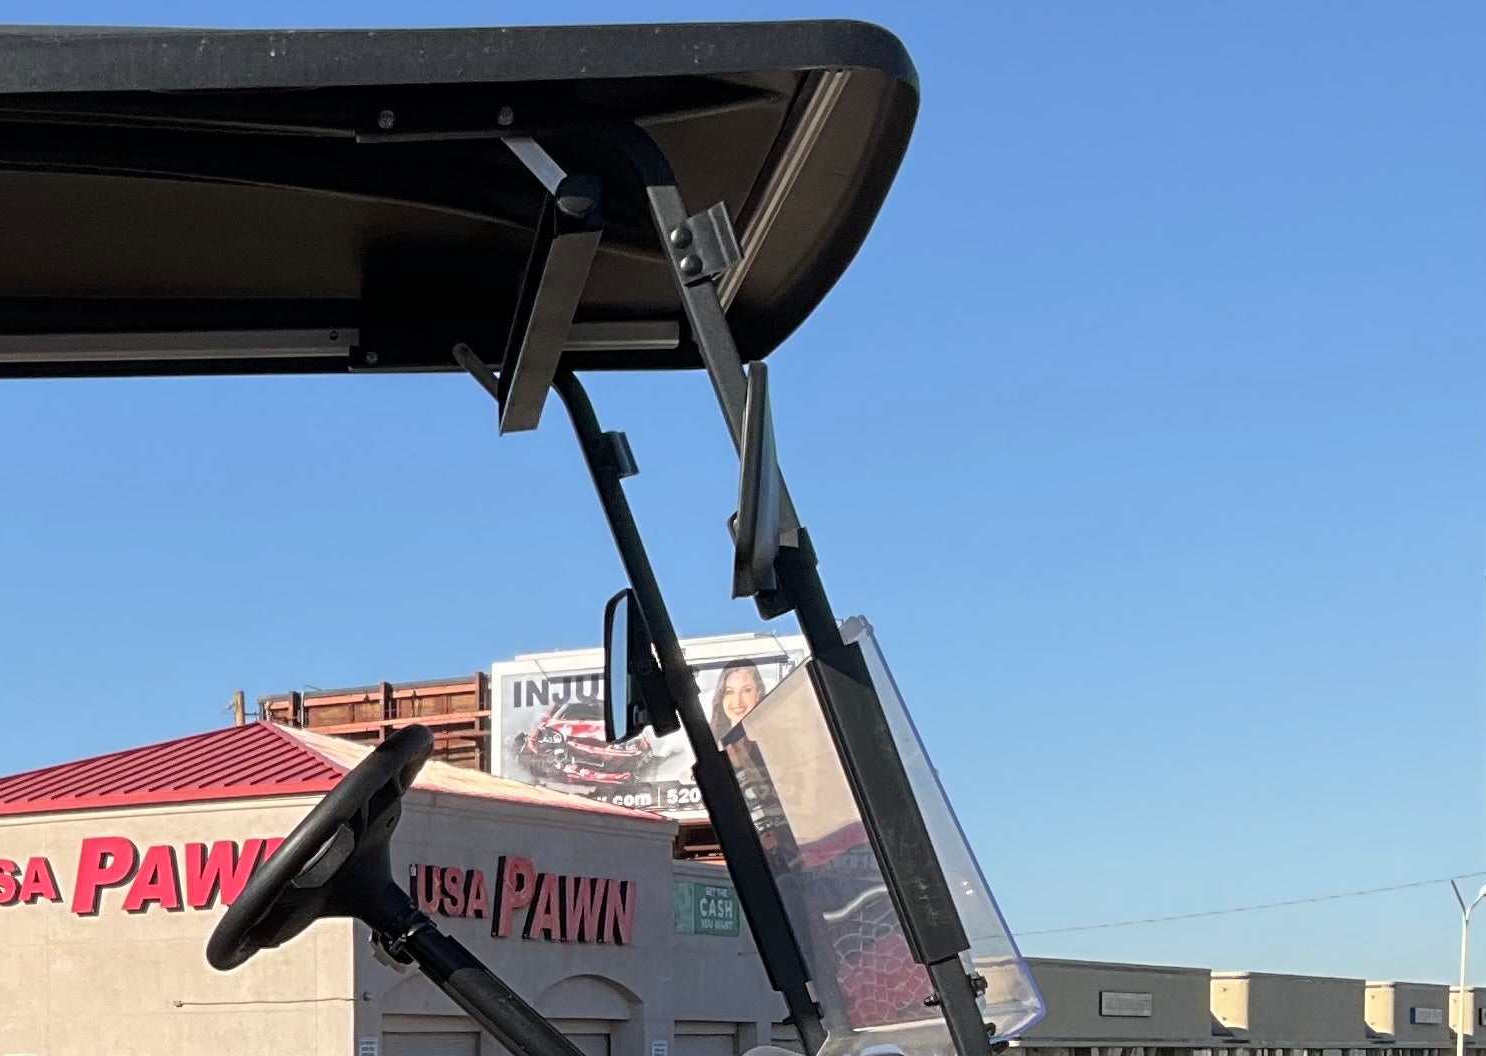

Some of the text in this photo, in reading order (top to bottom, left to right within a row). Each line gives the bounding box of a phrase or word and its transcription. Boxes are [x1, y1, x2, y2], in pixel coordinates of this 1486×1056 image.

[514, 675, 600, 708] INJU
[667, 788, 701, 804] 520
[410, 855, 636, 944] USA PAWN
[700, 898, 733, 918] CASH
